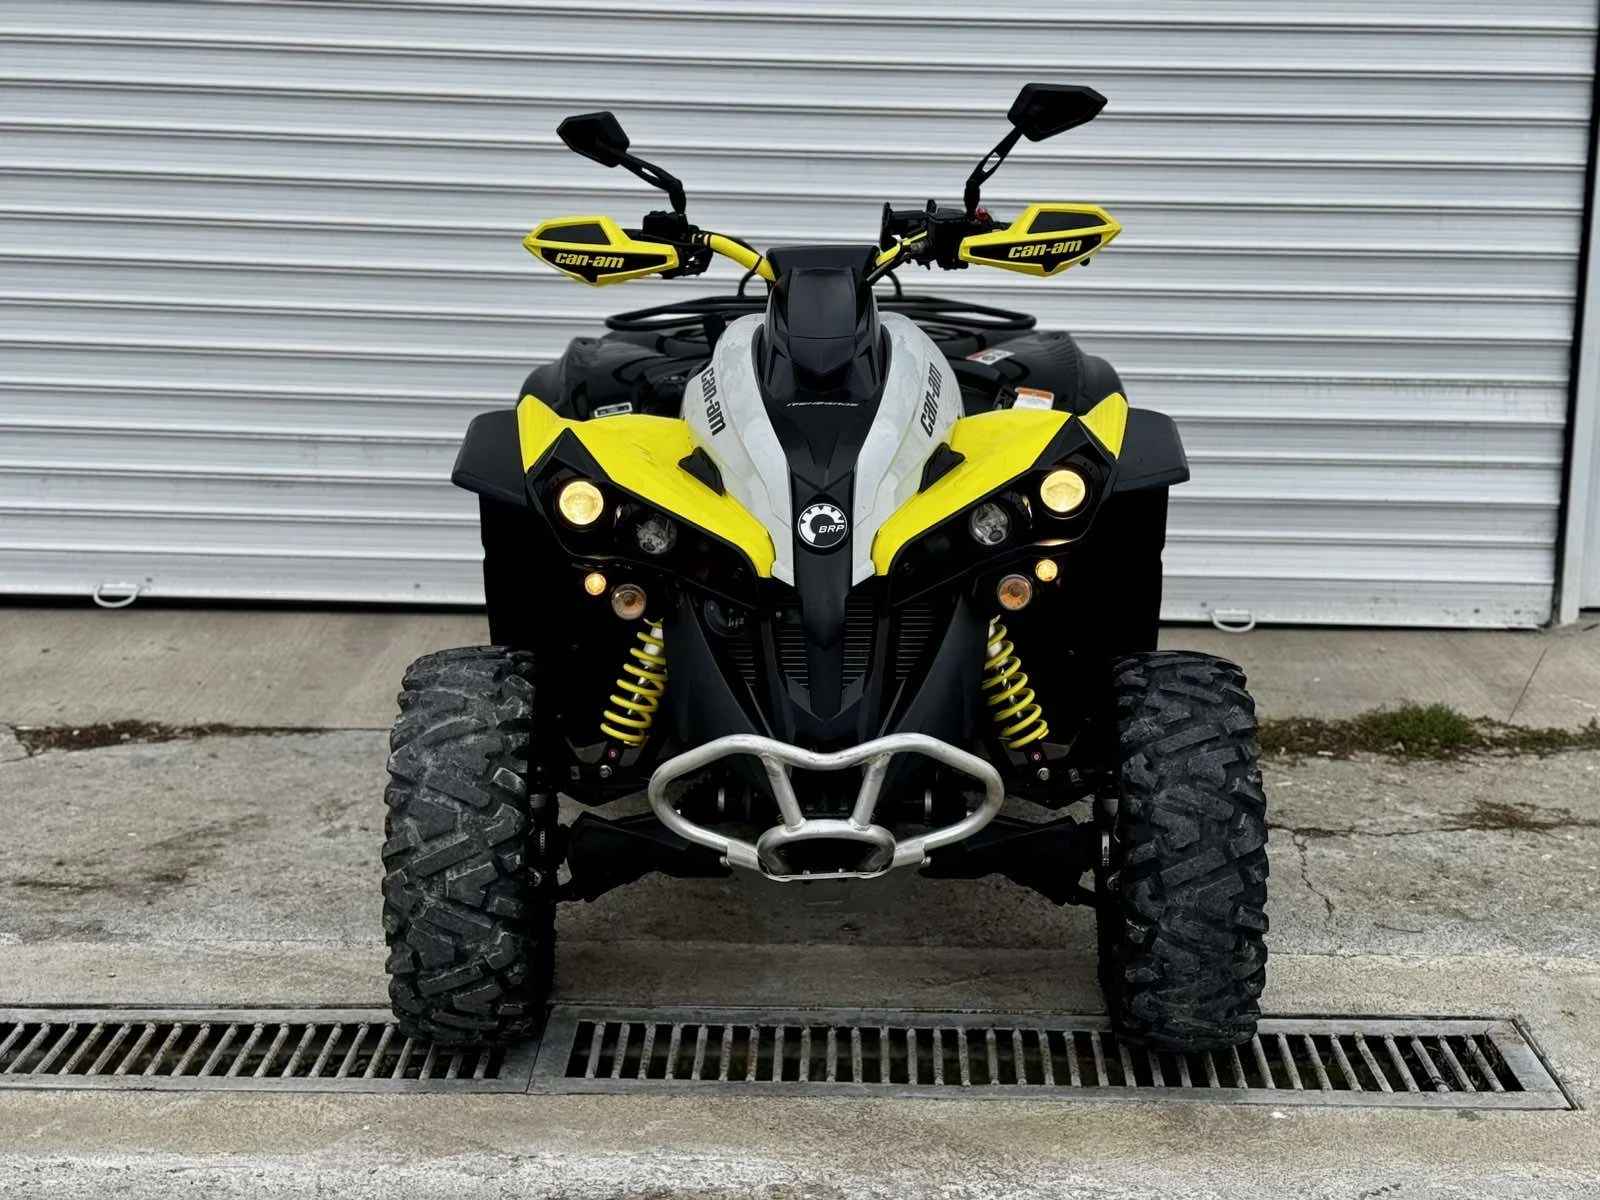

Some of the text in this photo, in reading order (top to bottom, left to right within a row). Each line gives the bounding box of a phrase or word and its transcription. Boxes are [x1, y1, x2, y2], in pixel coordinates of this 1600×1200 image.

[1008, 239, 1082, 259] can-am
[555, 252, 625, 269] can-am
[700, 366, 727, 437] can-am
[920, 361, 942, 438] can-am
[818, 524, 845, 534] BRP
